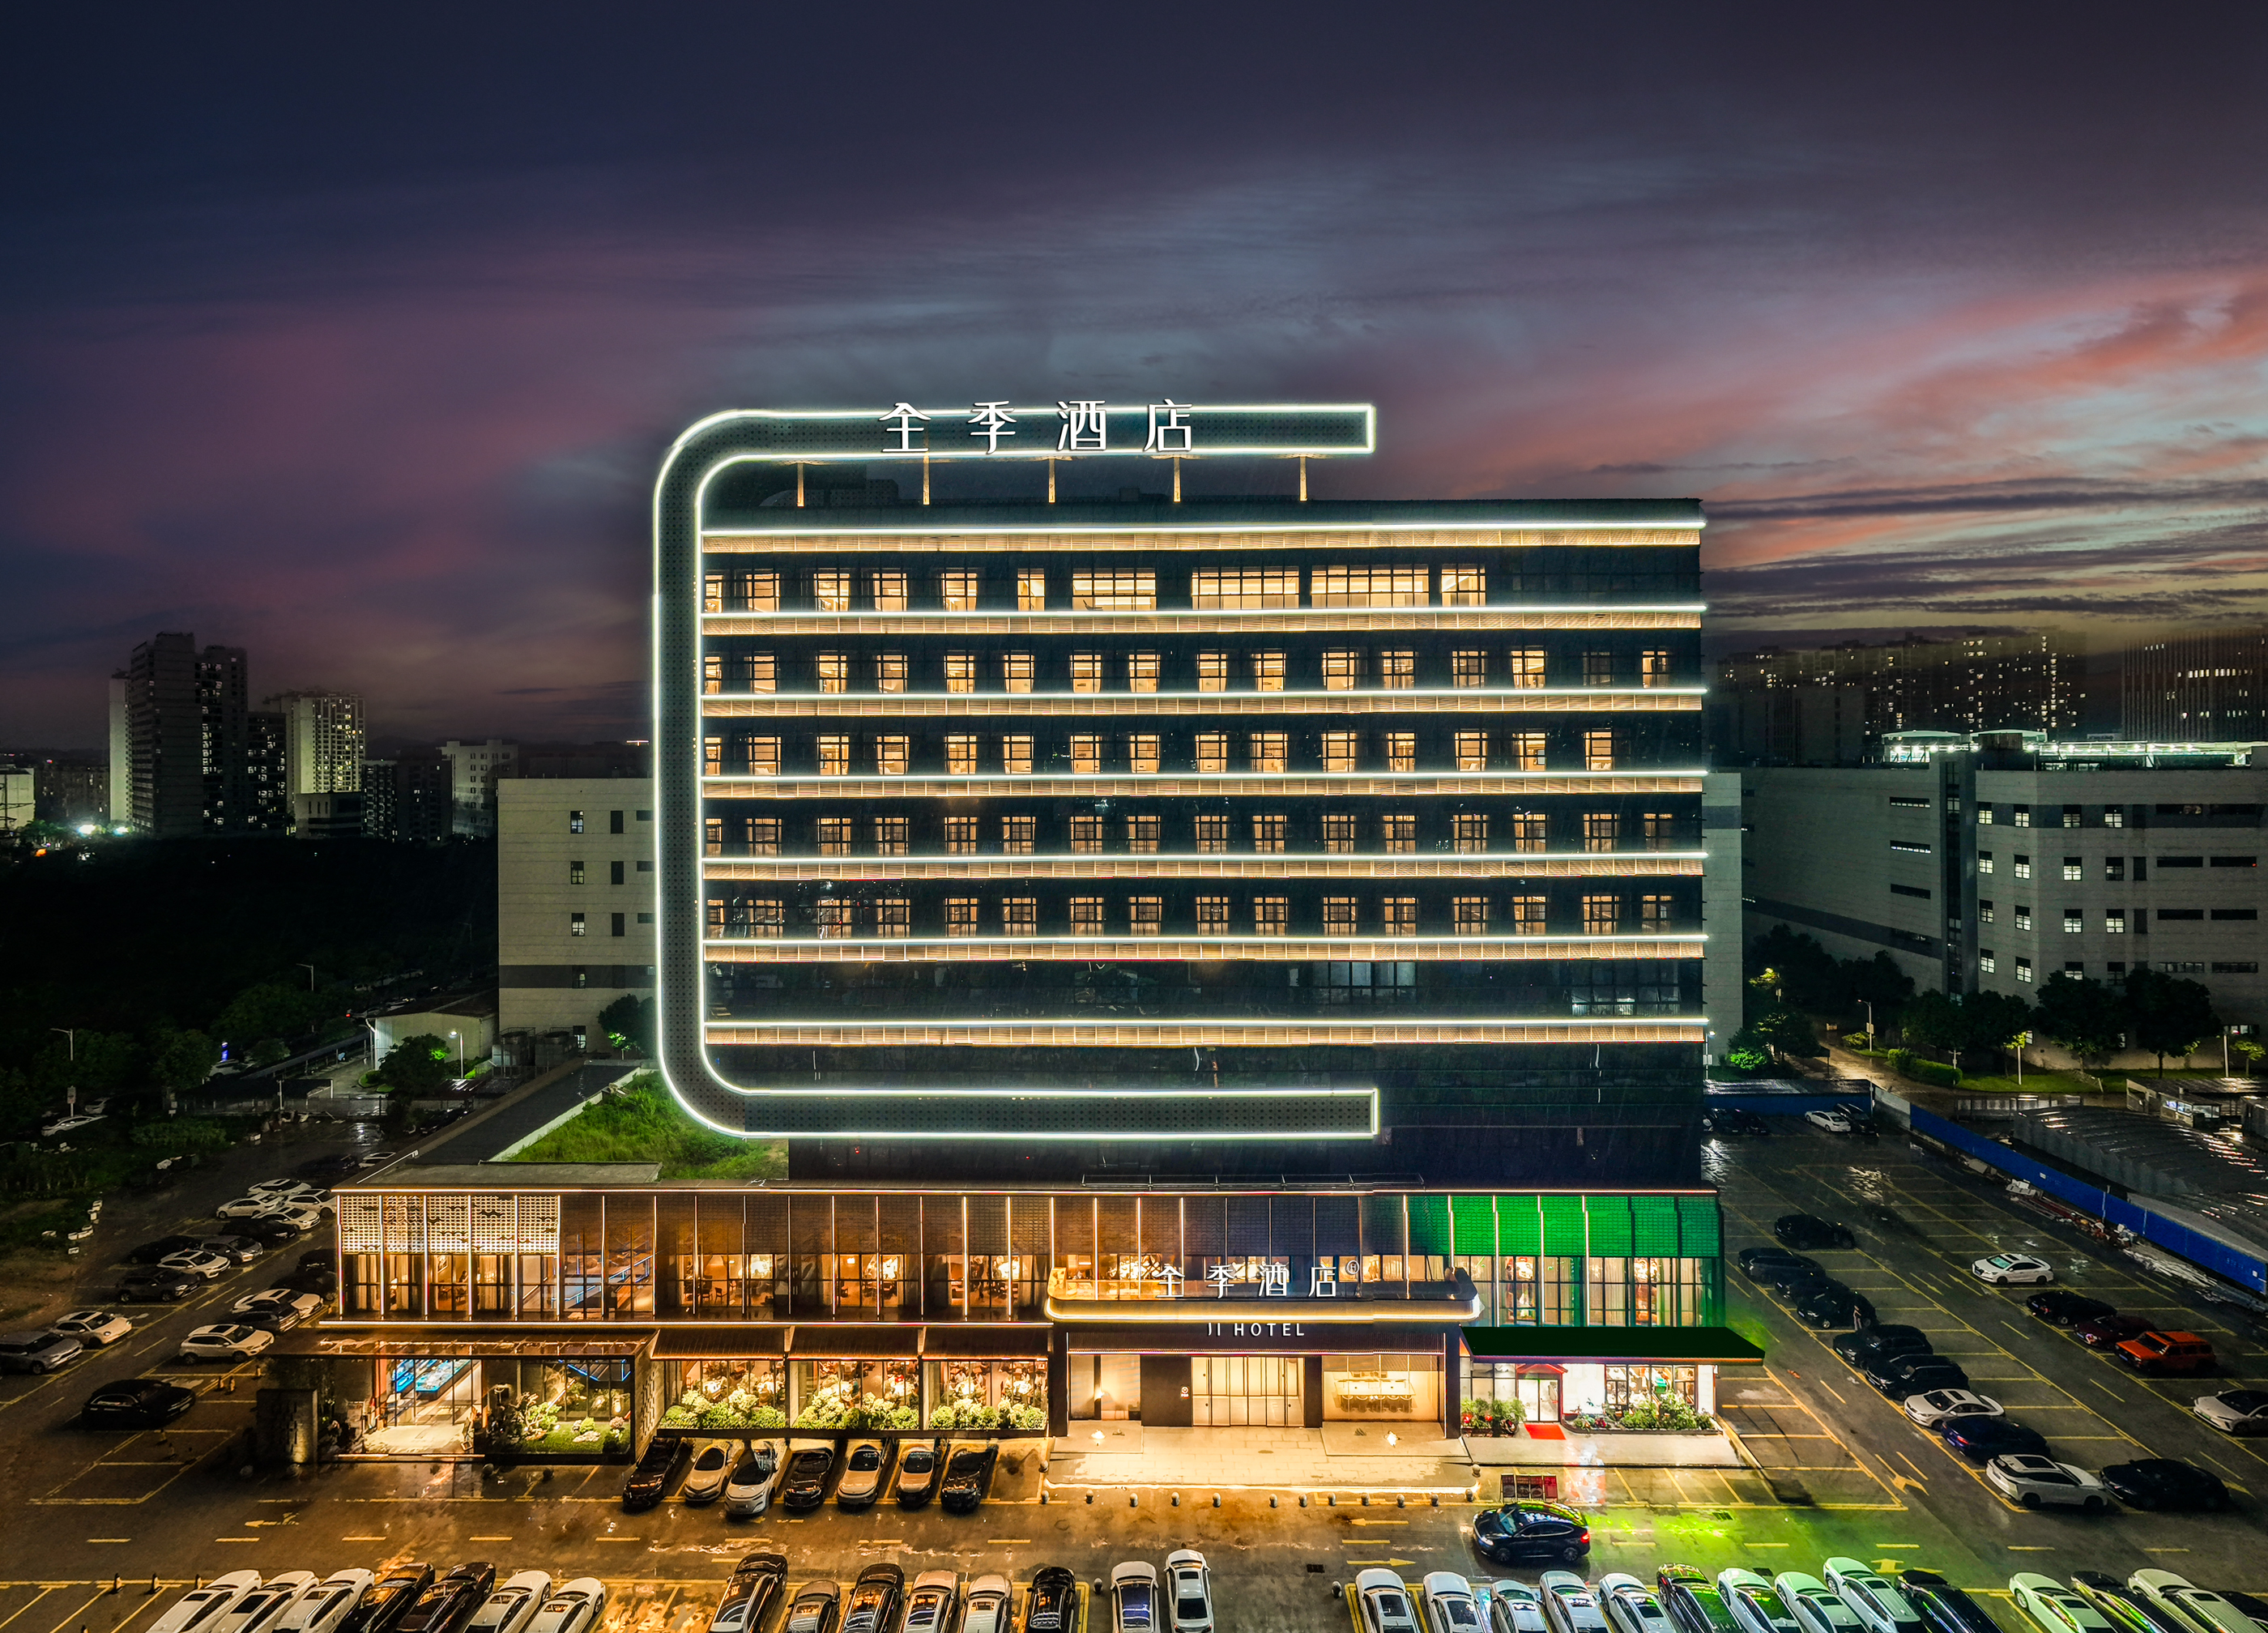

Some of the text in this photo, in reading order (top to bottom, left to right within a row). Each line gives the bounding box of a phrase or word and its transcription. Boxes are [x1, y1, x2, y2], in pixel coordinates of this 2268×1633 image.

[879, 399, 1194, 455] 全季酒店
[1154, 1264, 1337, 1299] 全季酒店
[1207, 1322, 1305, 1337] JI HOTEL
